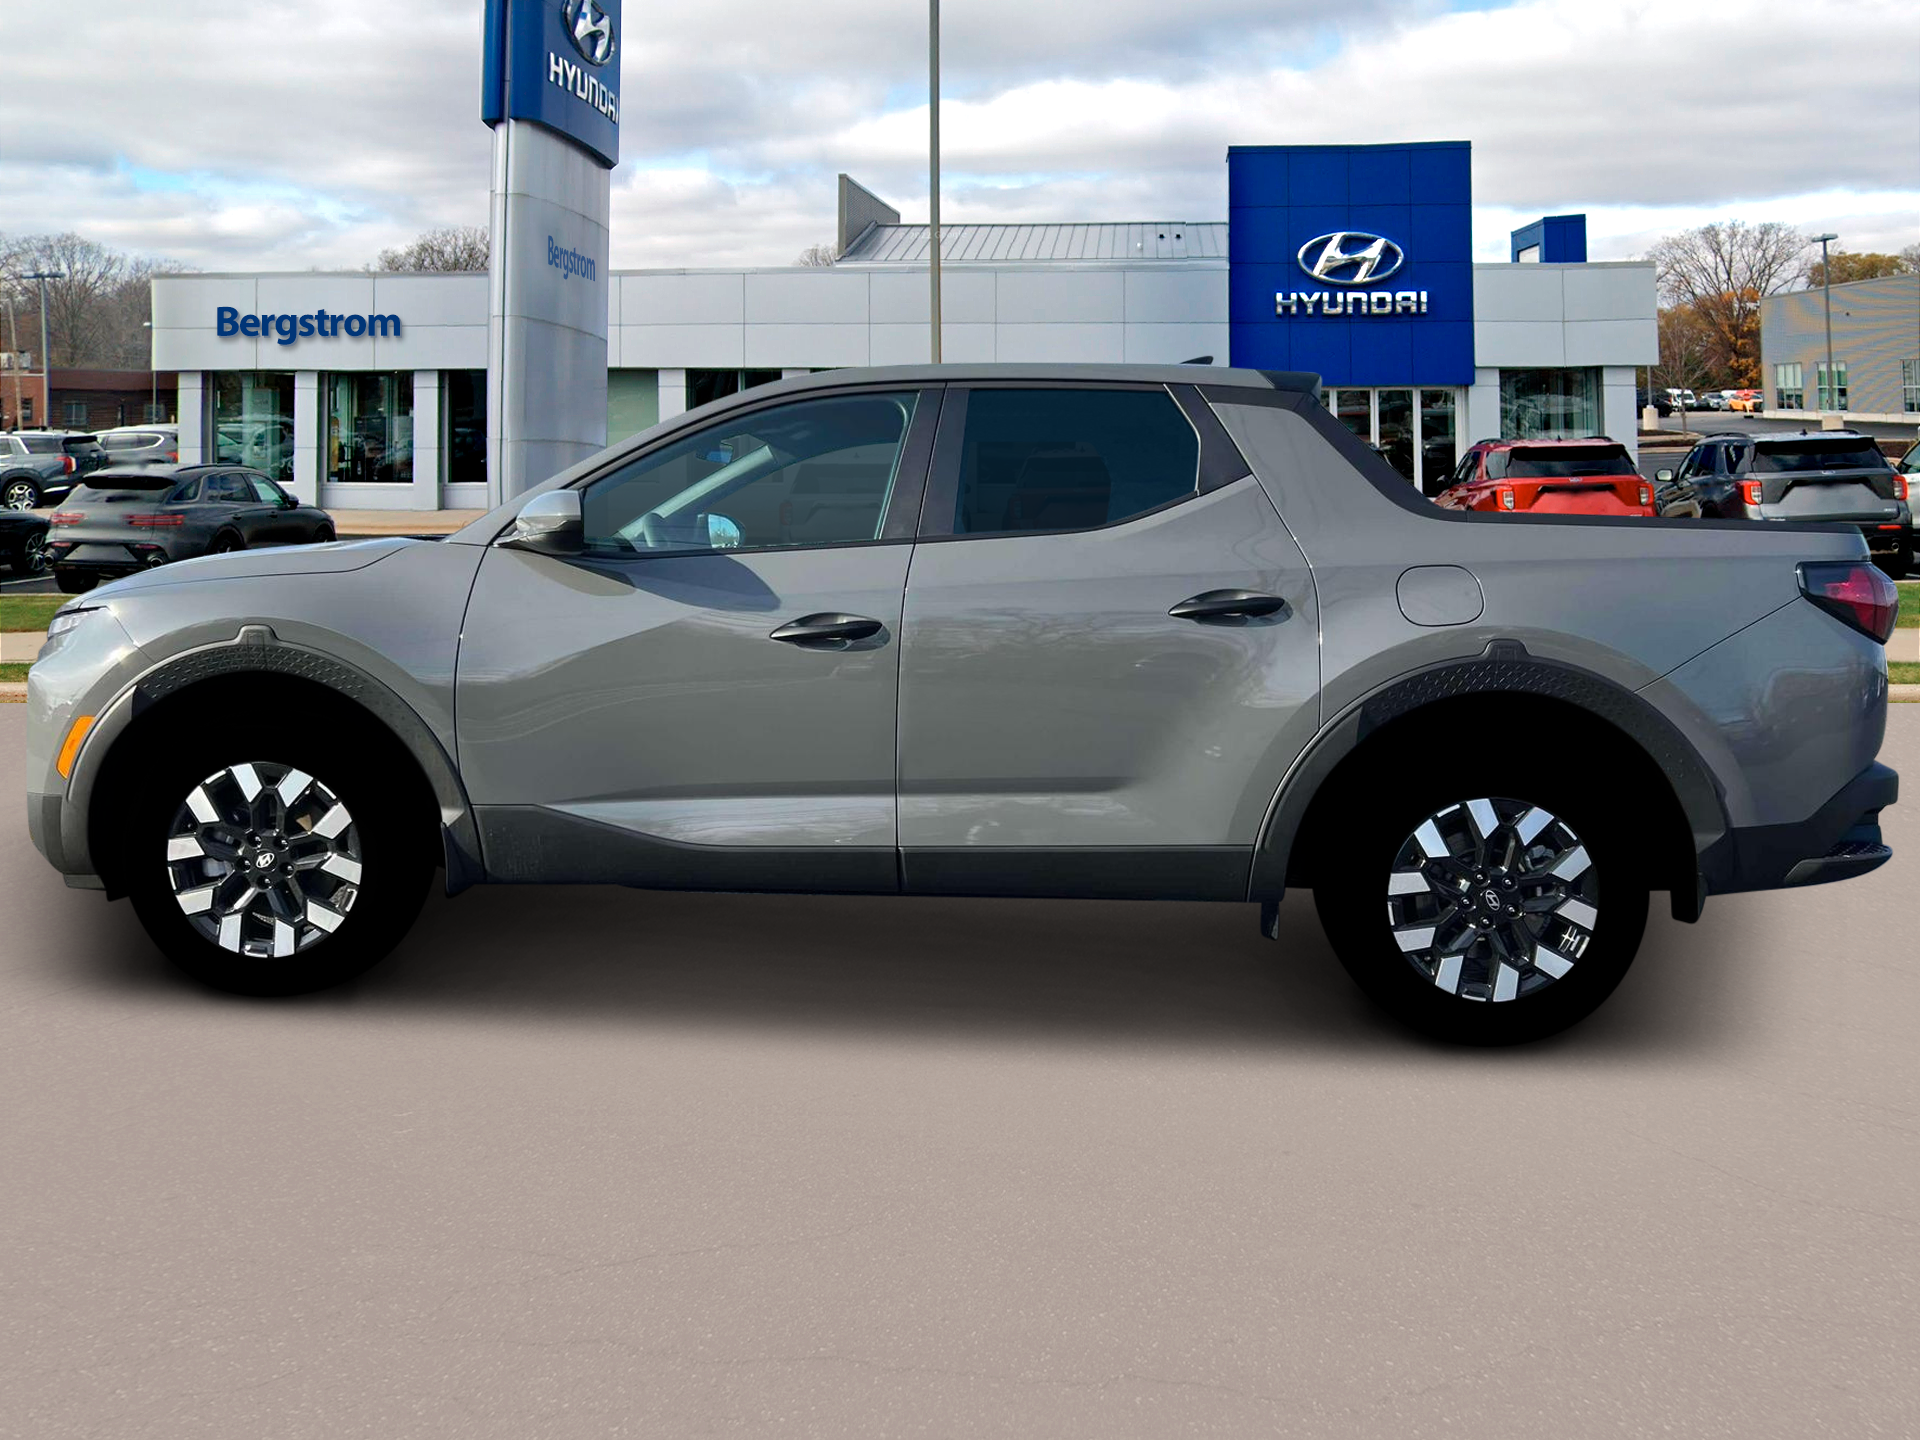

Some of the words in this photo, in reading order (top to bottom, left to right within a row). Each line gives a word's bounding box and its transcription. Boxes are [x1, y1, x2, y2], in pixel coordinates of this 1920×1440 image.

[548, 51, 619, 125] HYUNDAI
[547, 235, 596, 282] Bergstrom
[1275, 290, 1428, 315] HYUNDAI
[216, 306, 402, 346] Bergstrom
